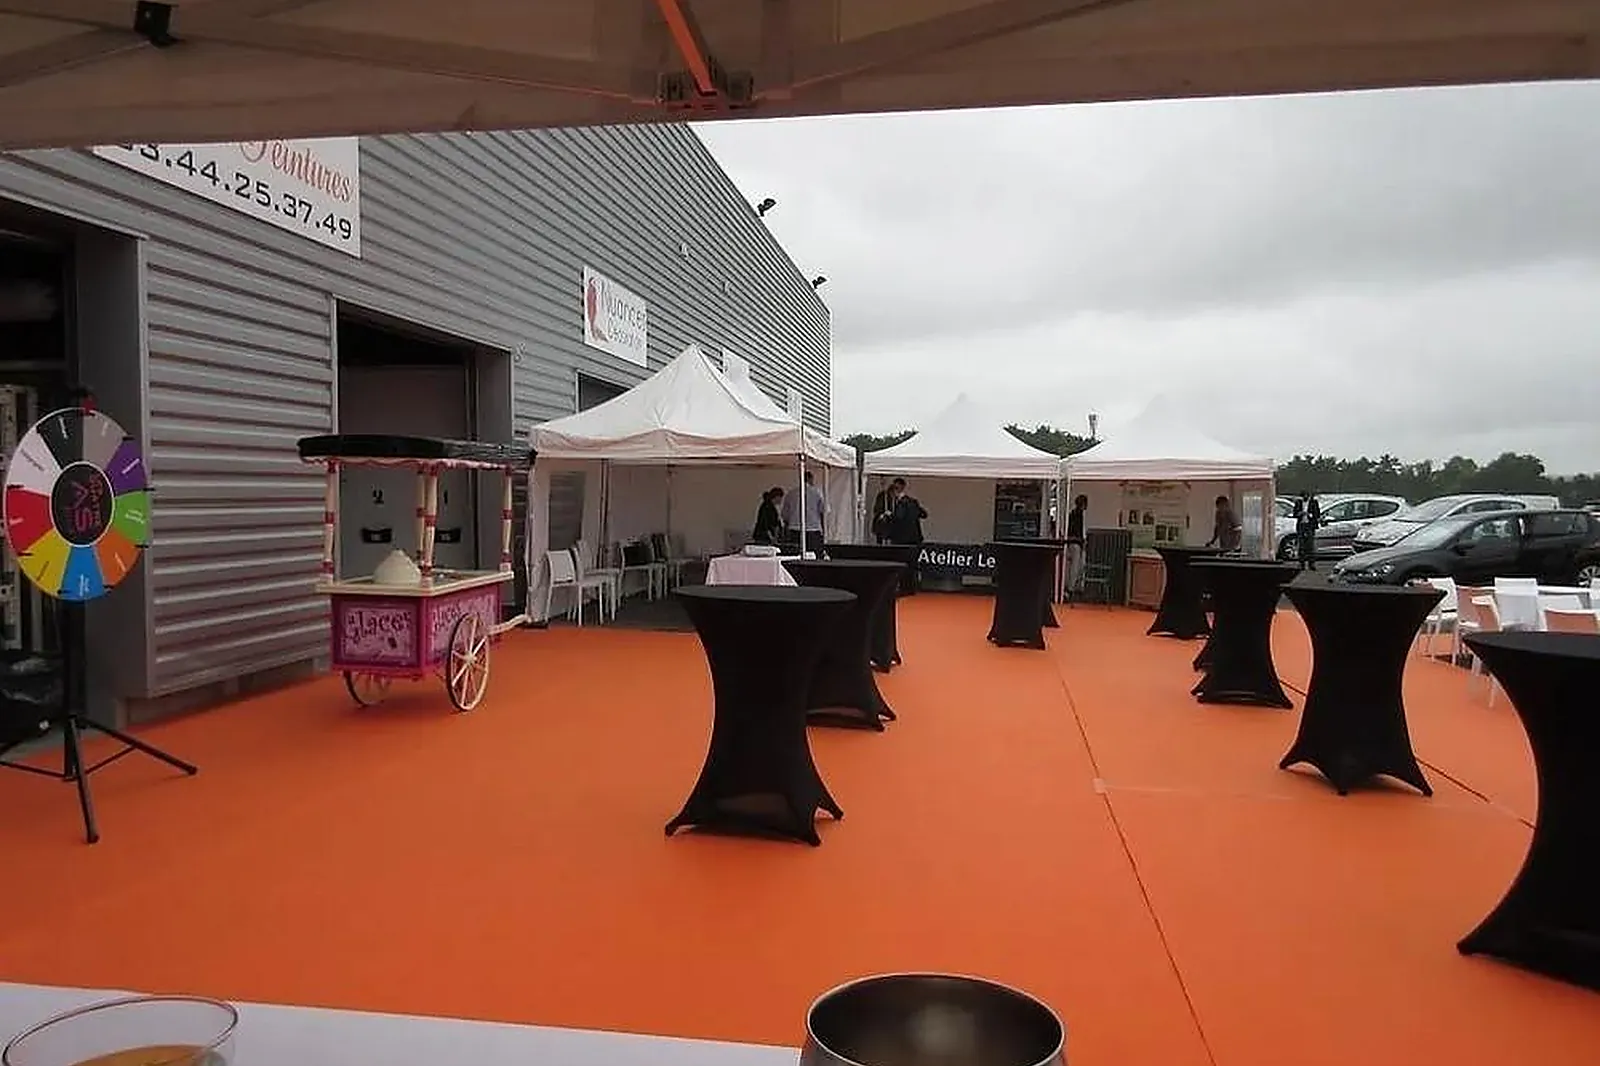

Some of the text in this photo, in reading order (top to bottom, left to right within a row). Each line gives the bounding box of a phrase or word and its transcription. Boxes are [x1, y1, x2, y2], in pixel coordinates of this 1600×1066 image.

[117, 142, 352, 240] 3.44.25.37.49
[918, 549, 996, 569] Atelier Le
